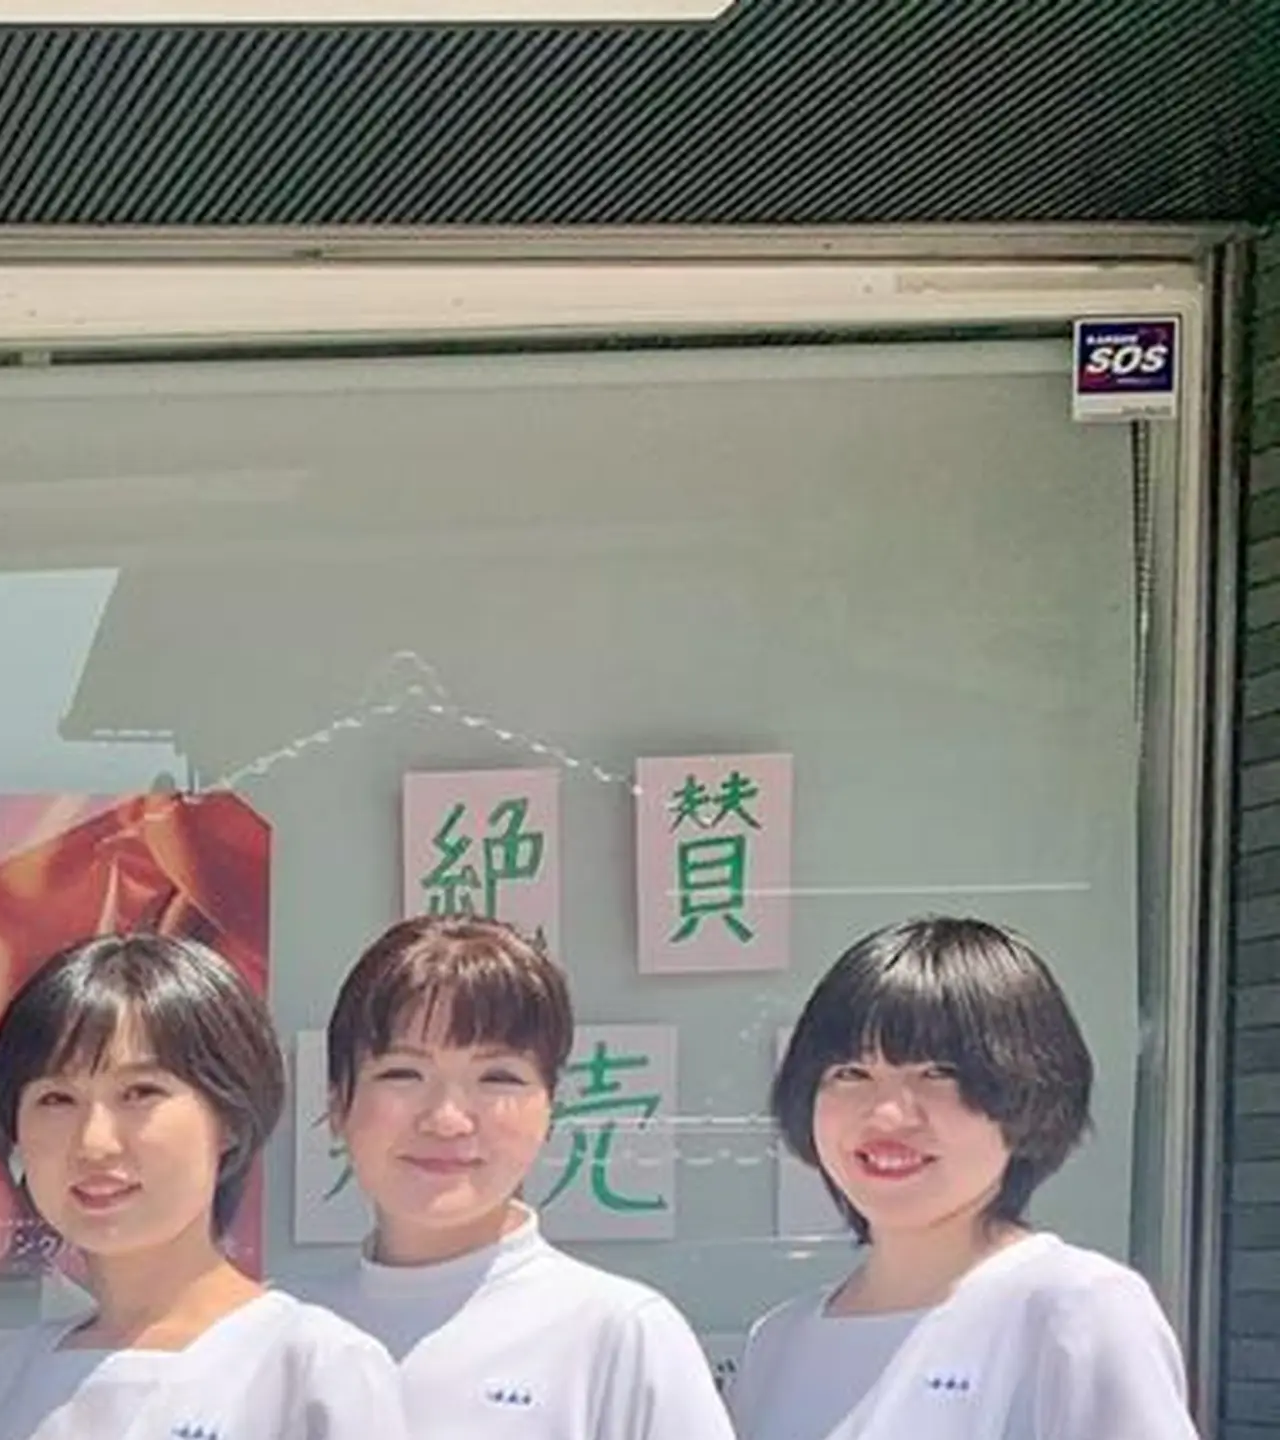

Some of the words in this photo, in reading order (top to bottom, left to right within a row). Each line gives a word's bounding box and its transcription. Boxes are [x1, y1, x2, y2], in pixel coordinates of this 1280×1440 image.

[1086, 345, 1169, 374] SOS
[668, 770, 763, 944] 賛
[540, 1042, 669, 1213] 売
